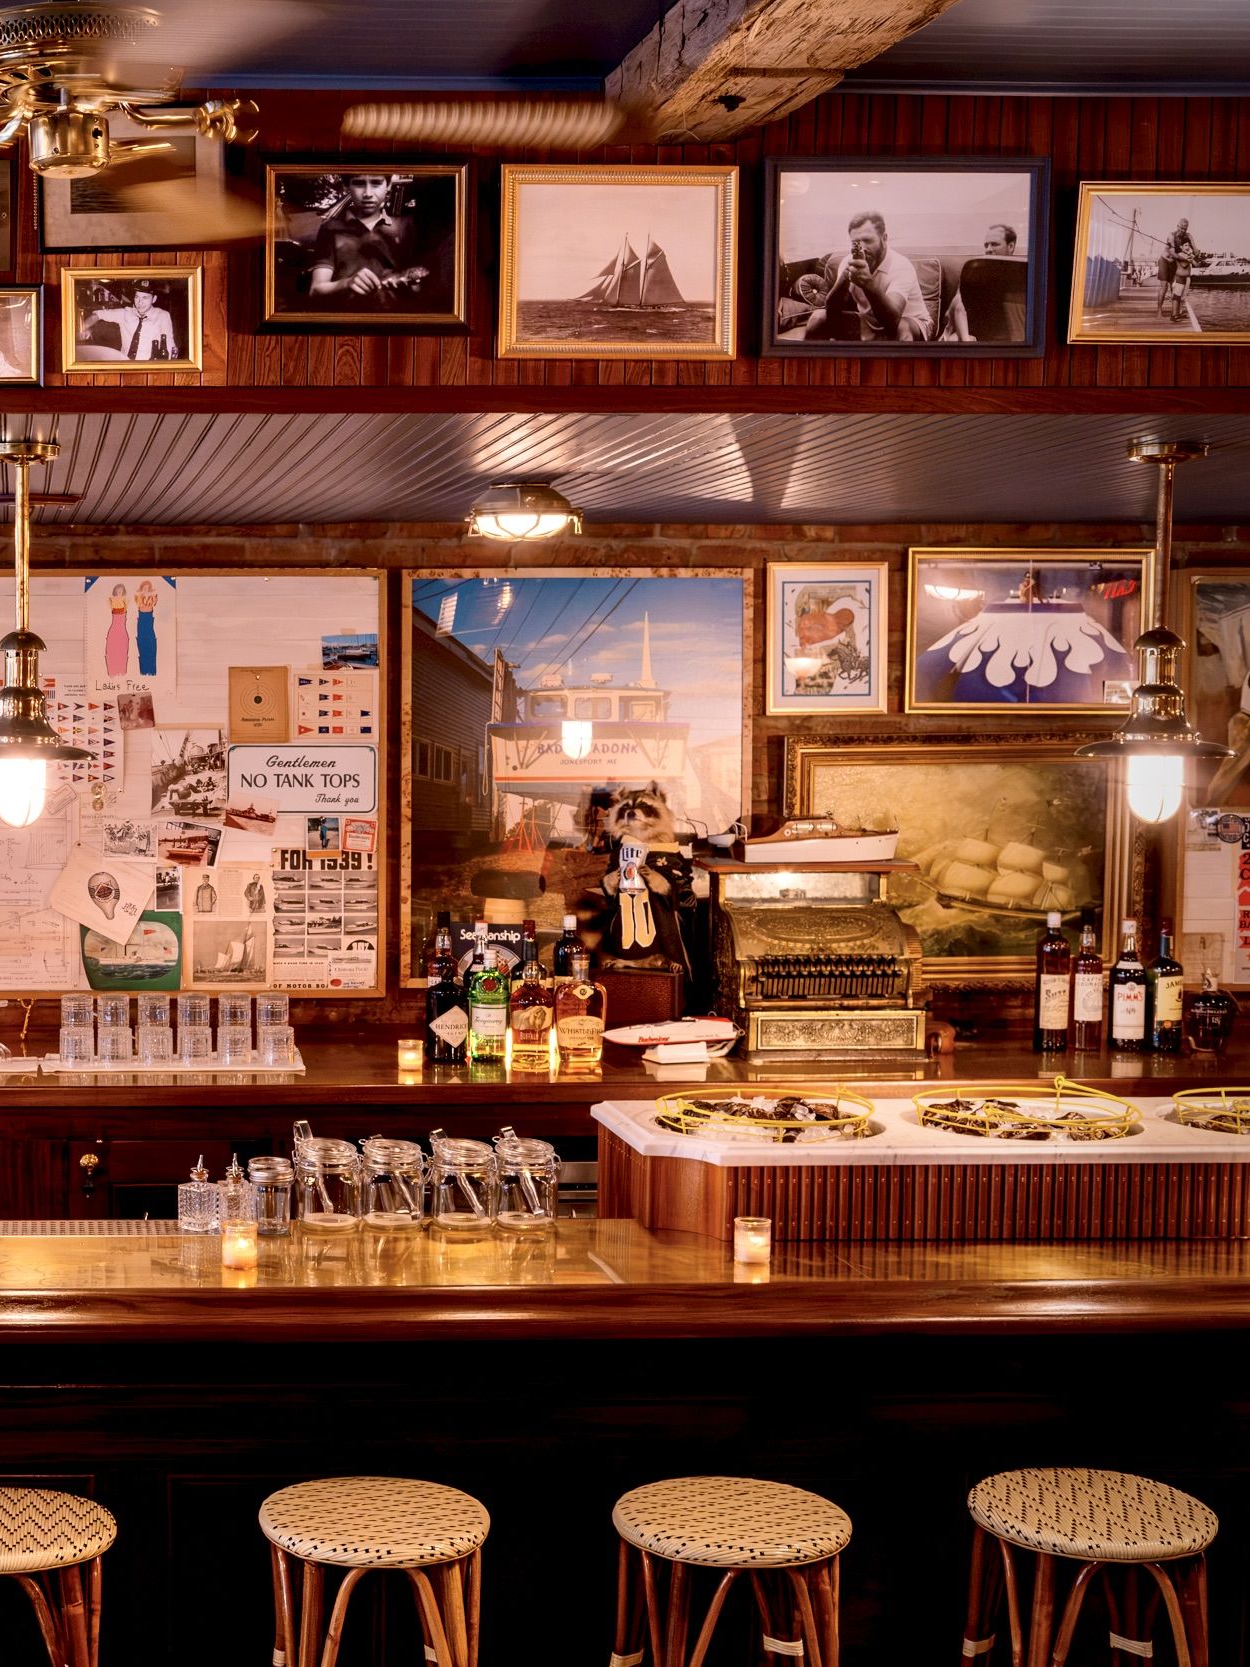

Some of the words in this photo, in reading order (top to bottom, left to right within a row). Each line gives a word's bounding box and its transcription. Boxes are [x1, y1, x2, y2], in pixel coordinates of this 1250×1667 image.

[95, 680, 121, 691] Ladies
[126, 680, 150, 691] Free
[266, 755, 337, 768] Gentlemen
[240, 774, 267, 788] NO
[273, 774, 315, 788] TANK
[317, 774, 360, 788] TOPS
[315, 793, 341, 804] Thank
[344, 795, 360, 807] you
[459, 929, 521, 944] Seaanship
[1117, 992, 1143, 1002] PIMM'S
